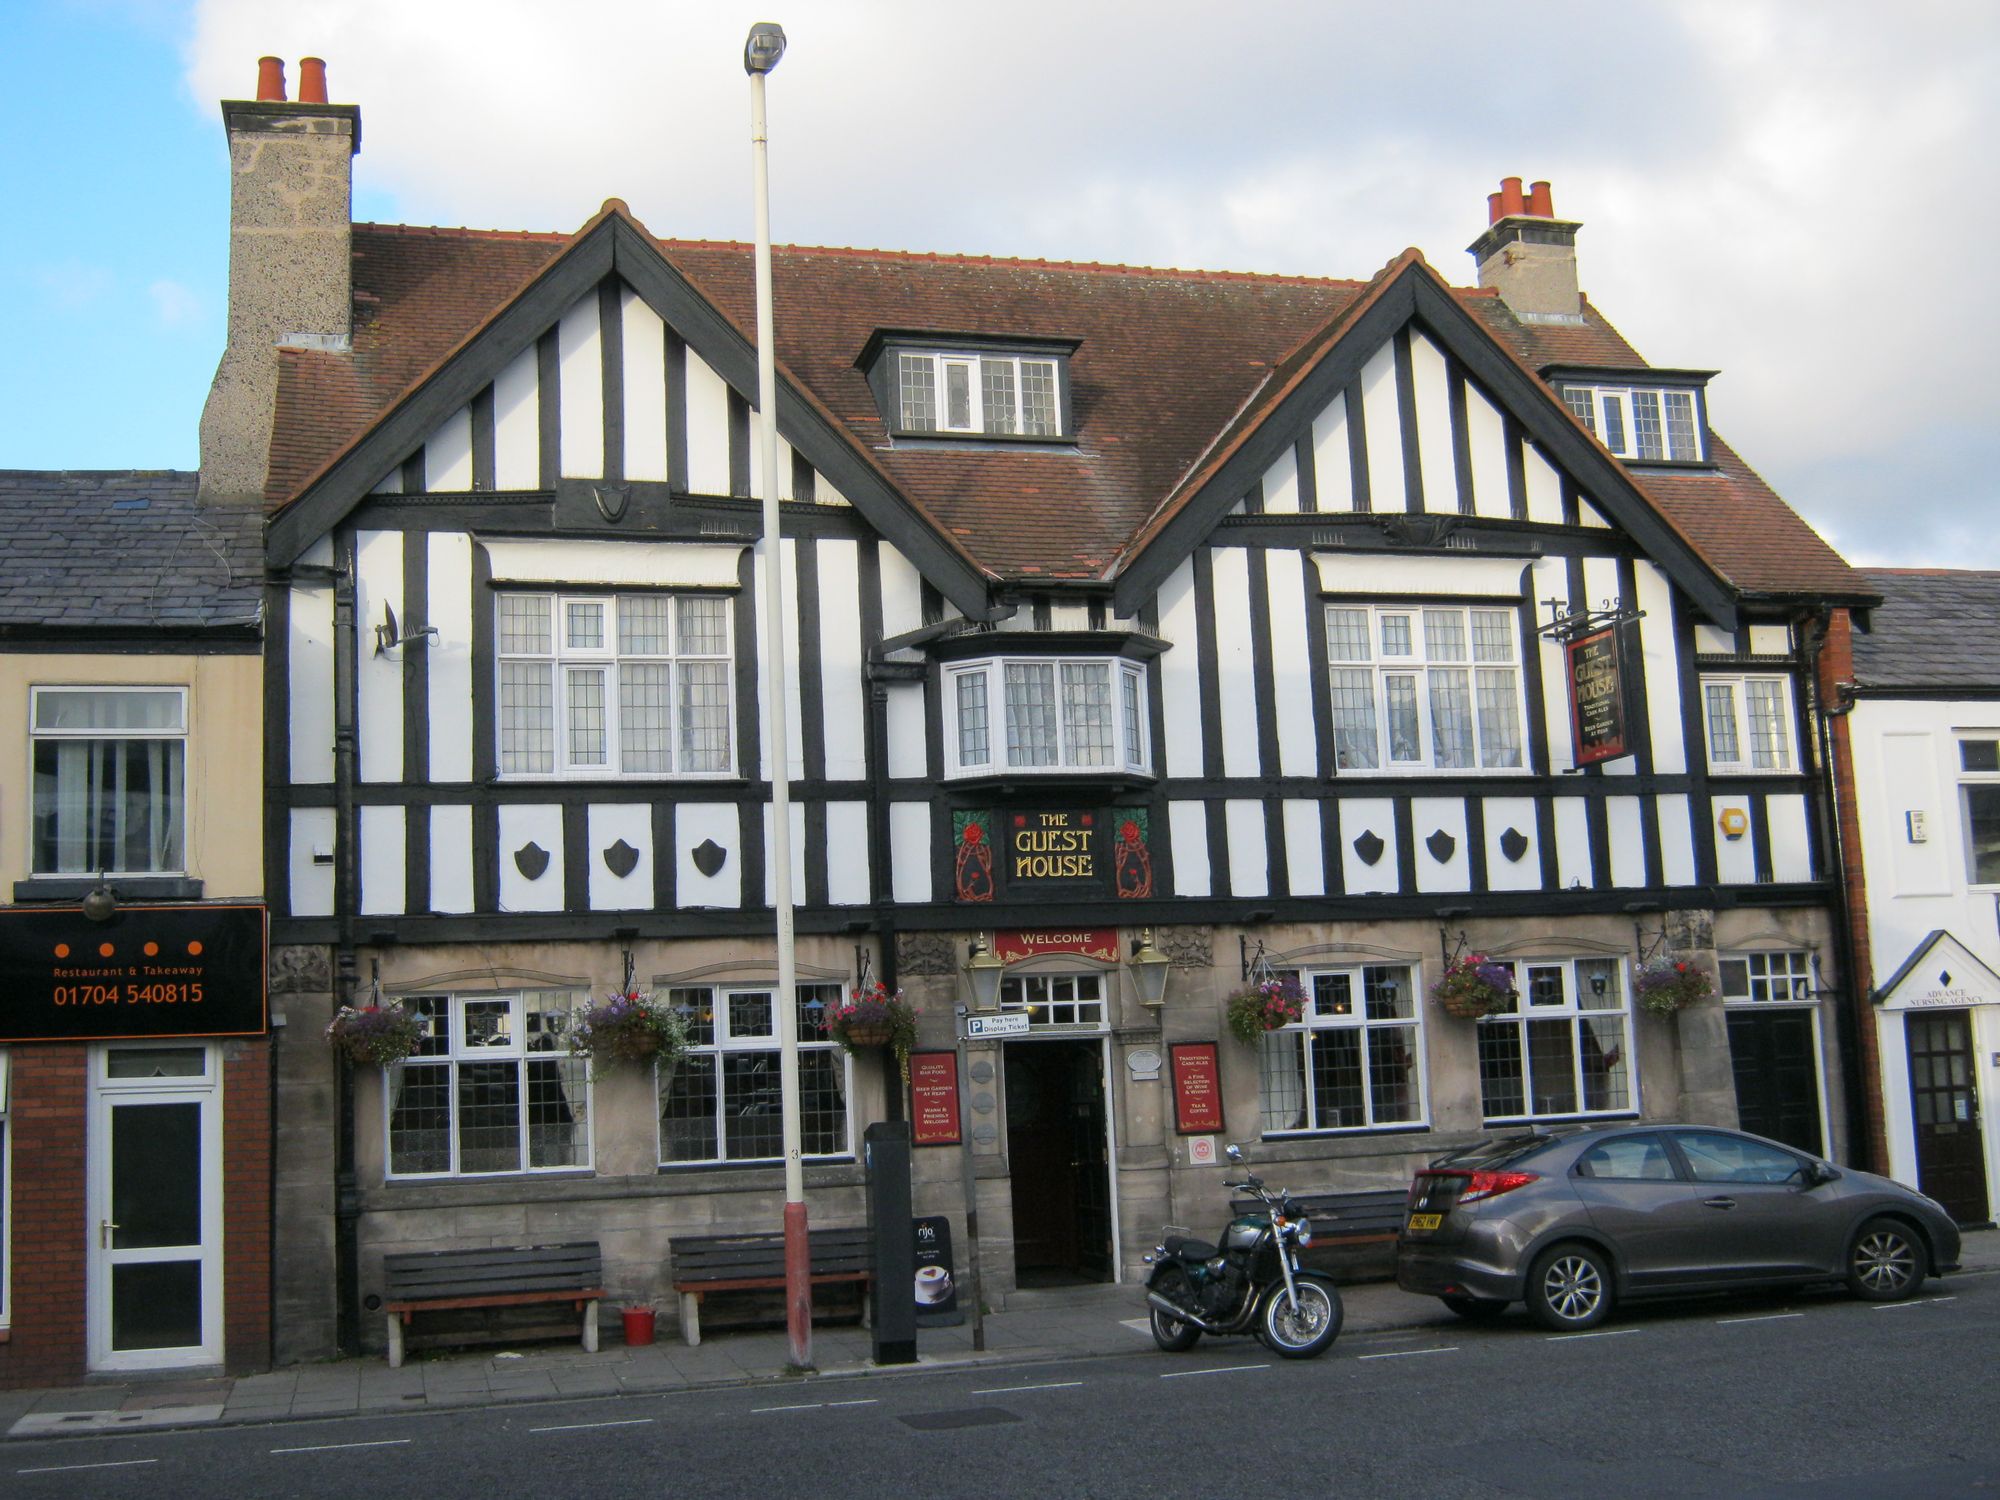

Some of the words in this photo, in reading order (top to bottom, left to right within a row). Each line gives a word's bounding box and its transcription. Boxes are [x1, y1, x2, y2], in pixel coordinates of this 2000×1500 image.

[1584, 645, 1599, 658] THE
[1576, 655, 1612, 682] GUEST
[1576, 676, 1615, 704] HOUSE
[1039, 813, 1068, 826] THE
[1015, 830, 1092, 852] GUEST
[1016, 854, 1093, 878] HOUSE
[1020, 933, 1092, 945] WELCOME
[54, 967, 123, 978] Restaurant
[129, 966, 137, 976] &
[143, 966, 203, 977] Takeaway
[54, 985, 118, 1006] 01704
[127, 983, 203, 1004] 540815
[1927, 989, 1966, 998] ADVANCE
[1910, 998, 1947, 1006] NURSING
[972, 1022, 981, 1032] P
[791, 1149, 798, 1159] 3
